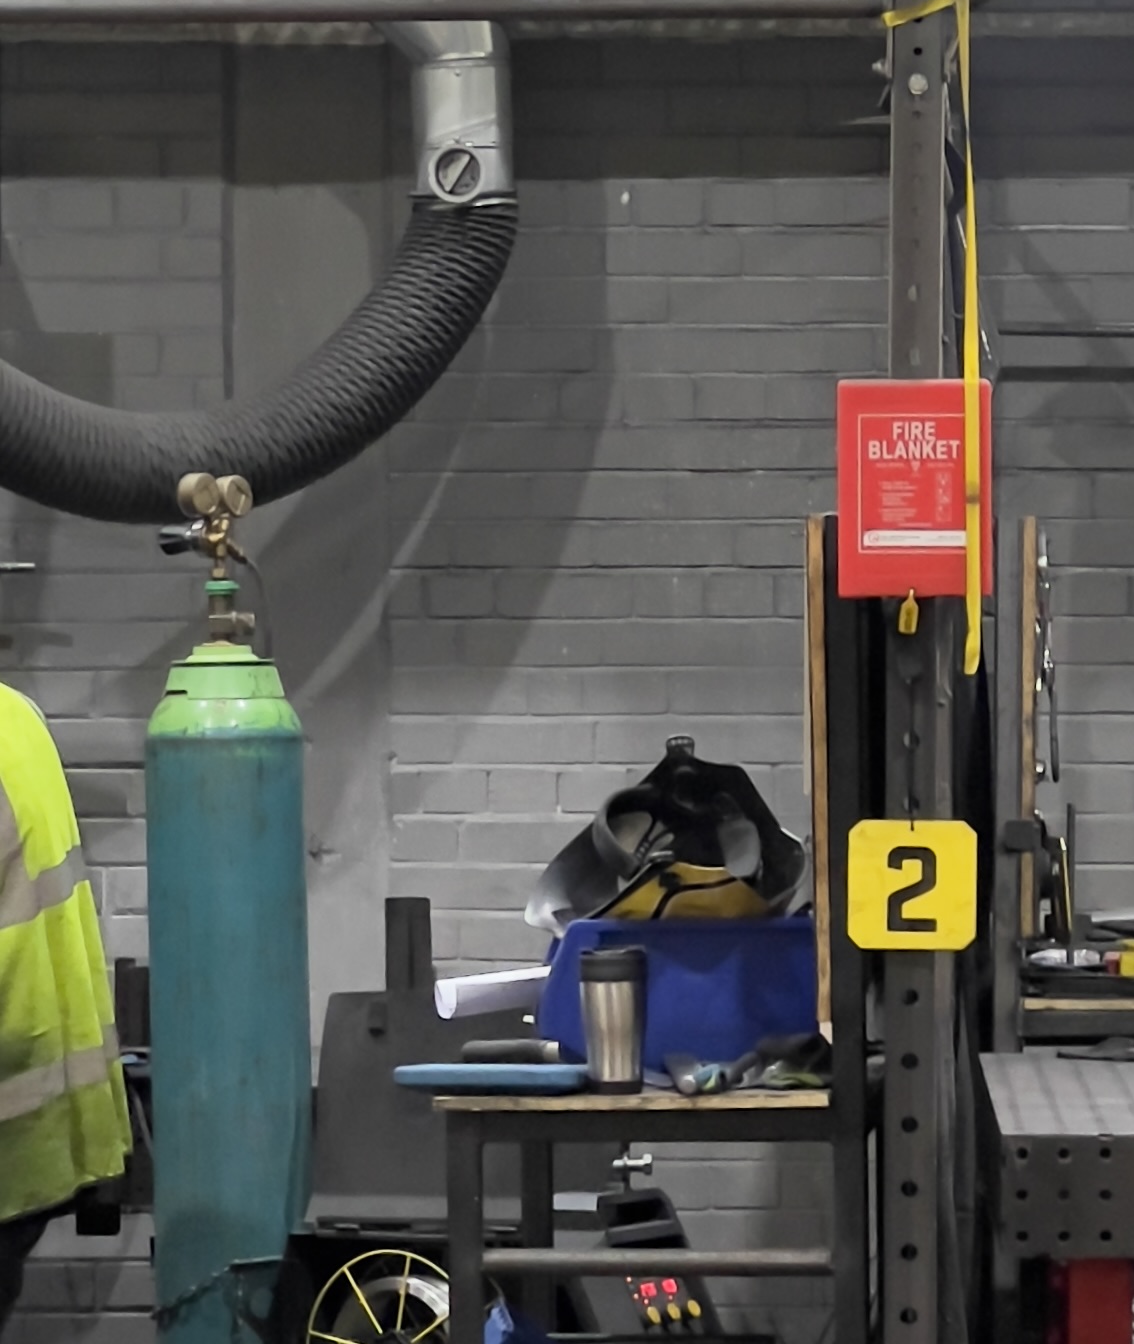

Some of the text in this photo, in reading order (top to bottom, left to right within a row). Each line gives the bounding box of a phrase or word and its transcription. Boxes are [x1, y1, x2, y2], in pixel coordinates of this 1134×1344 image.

[892, 421, 936, 441] FIRE
[868, 440, 960, 460] BLANKET
[887, 845, 937, 933] 2
